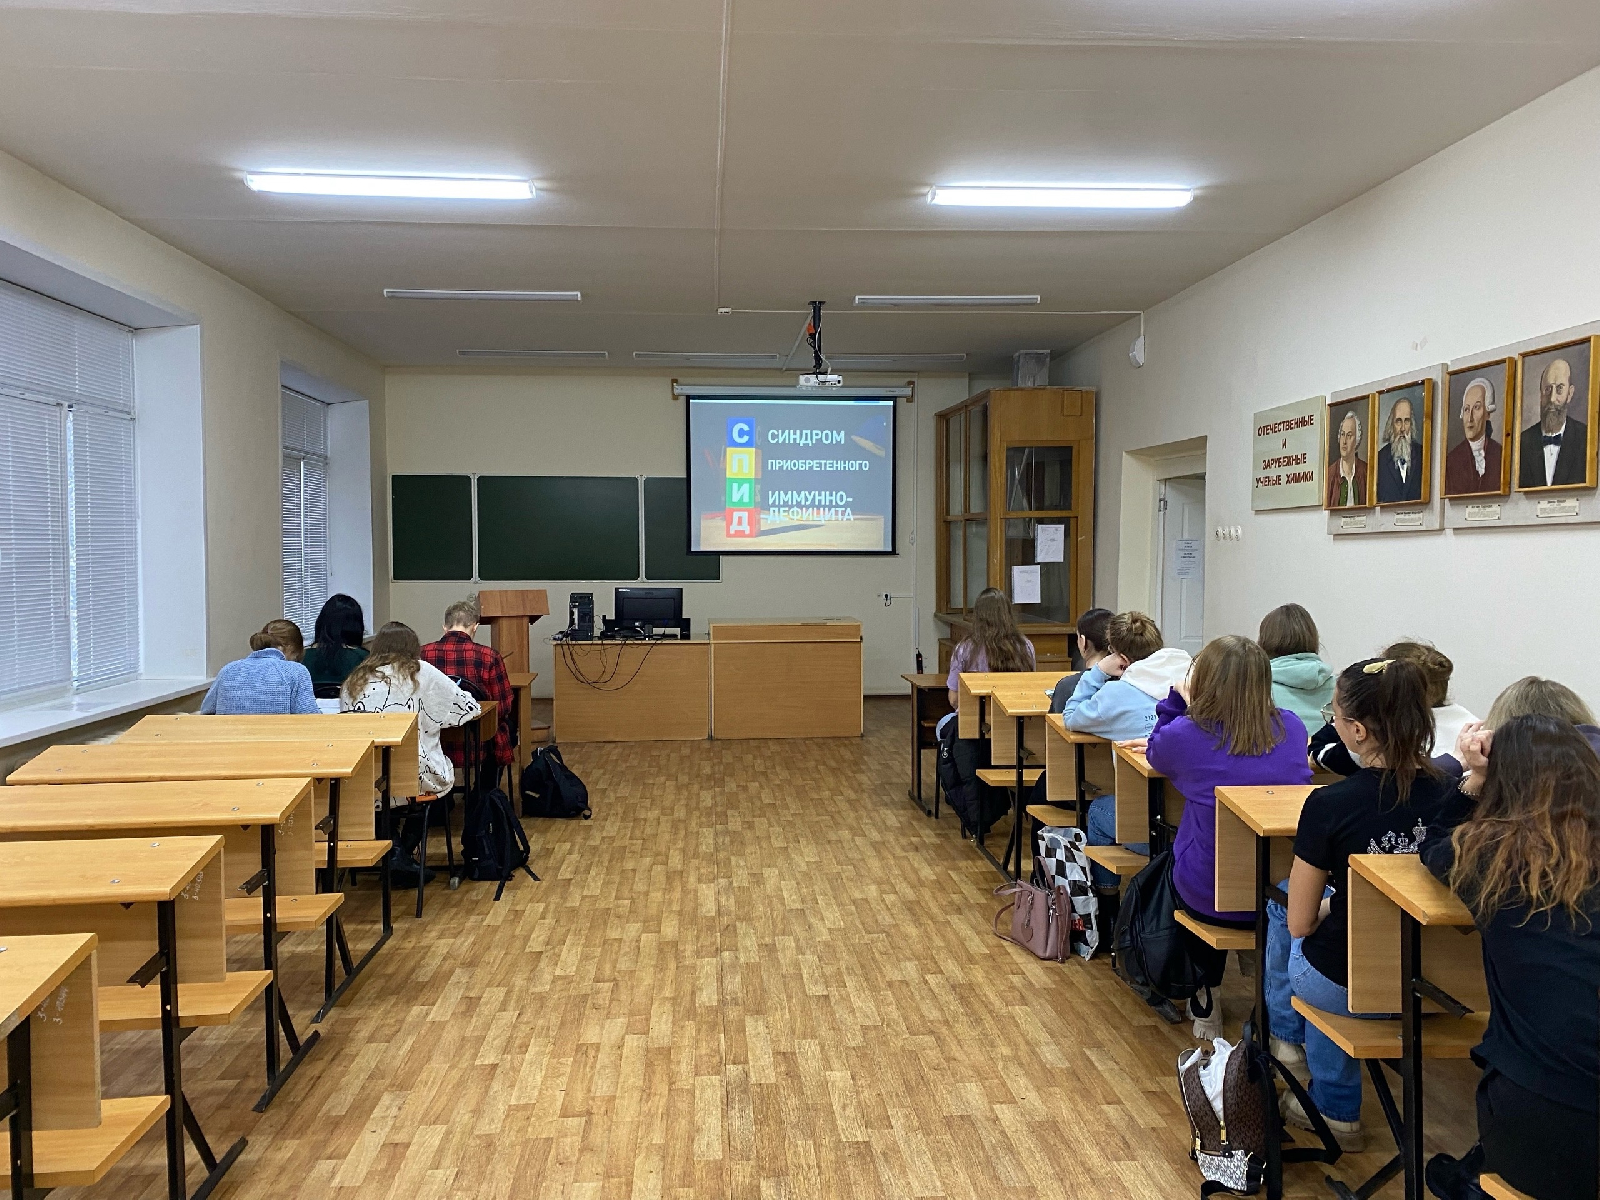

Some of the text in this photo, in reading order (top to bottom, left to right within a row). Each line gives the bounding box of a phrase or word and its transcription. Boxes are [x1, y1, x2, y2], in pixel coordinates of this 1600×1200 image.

[1257, 415, 1314, 436] ОТЕЧЕСТВЕННЫЕ
[768, 430, 845, 446] СИНДРОМ
[1282, 438, 1286, 449] И
[768, 460, 869, 470] ПРИОБРЕТЕННОГО
[1262, 453, 1307, 470] ЗАРУБЕЖНЫЕ
[1256, 471, 1314, 488] УЧЕНЫЕ ХИМИКИ
[768, 491, 853, 505] ИММУННО-
[767, 506, 854, 524] ДЕФИЦИТА
